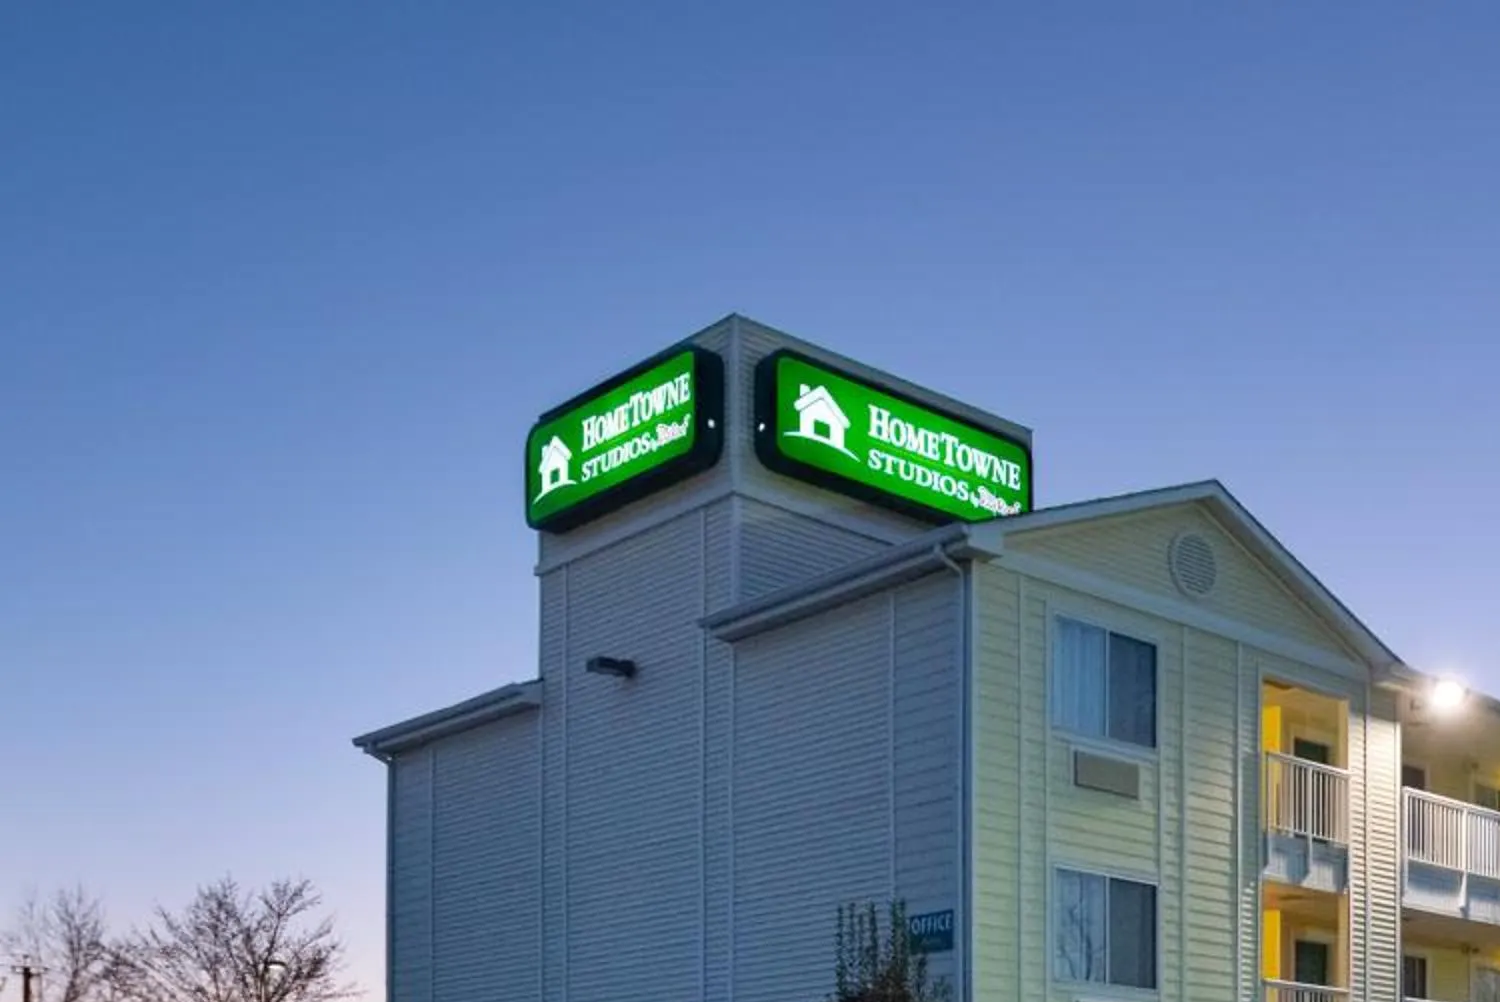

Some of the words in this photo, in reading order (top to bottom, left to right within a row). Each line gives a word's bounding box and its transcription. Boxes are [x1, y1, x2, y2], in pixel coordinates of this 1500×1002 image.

[580, 432, 651, 483] STUDIOS
[867, 448, 970, 502] STUDIOS
[910, 913, 952, 936] OFFICE
